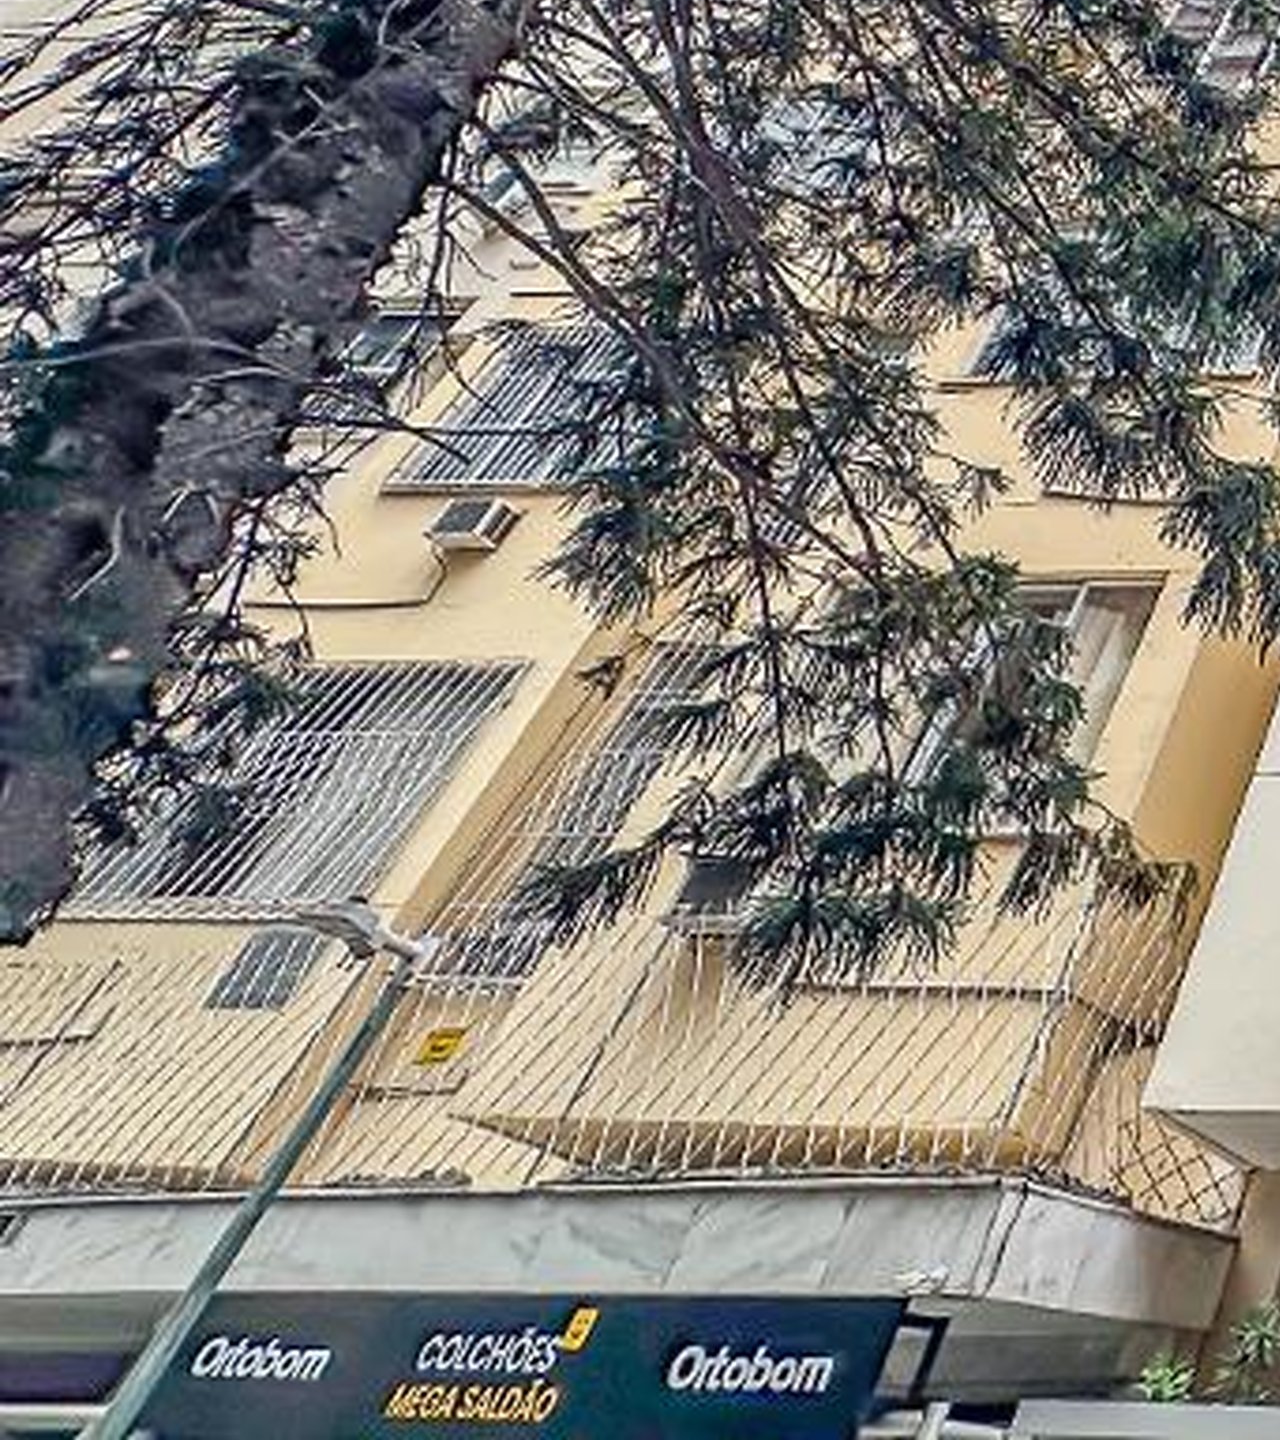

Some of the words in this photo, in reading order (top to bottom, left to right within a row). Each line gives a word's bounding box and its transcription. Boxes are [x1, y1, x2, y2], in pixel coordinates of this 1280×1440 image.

[190, 1336, 332, 1381] Ortobom
[416, 1326, 559, 1373] COLCHÕES
[667, 1344, 834, 1393] Ortobom
[384, 1382, 459, 1419] MEGA
[456, 1378, 559, 1423] SALDÃO
